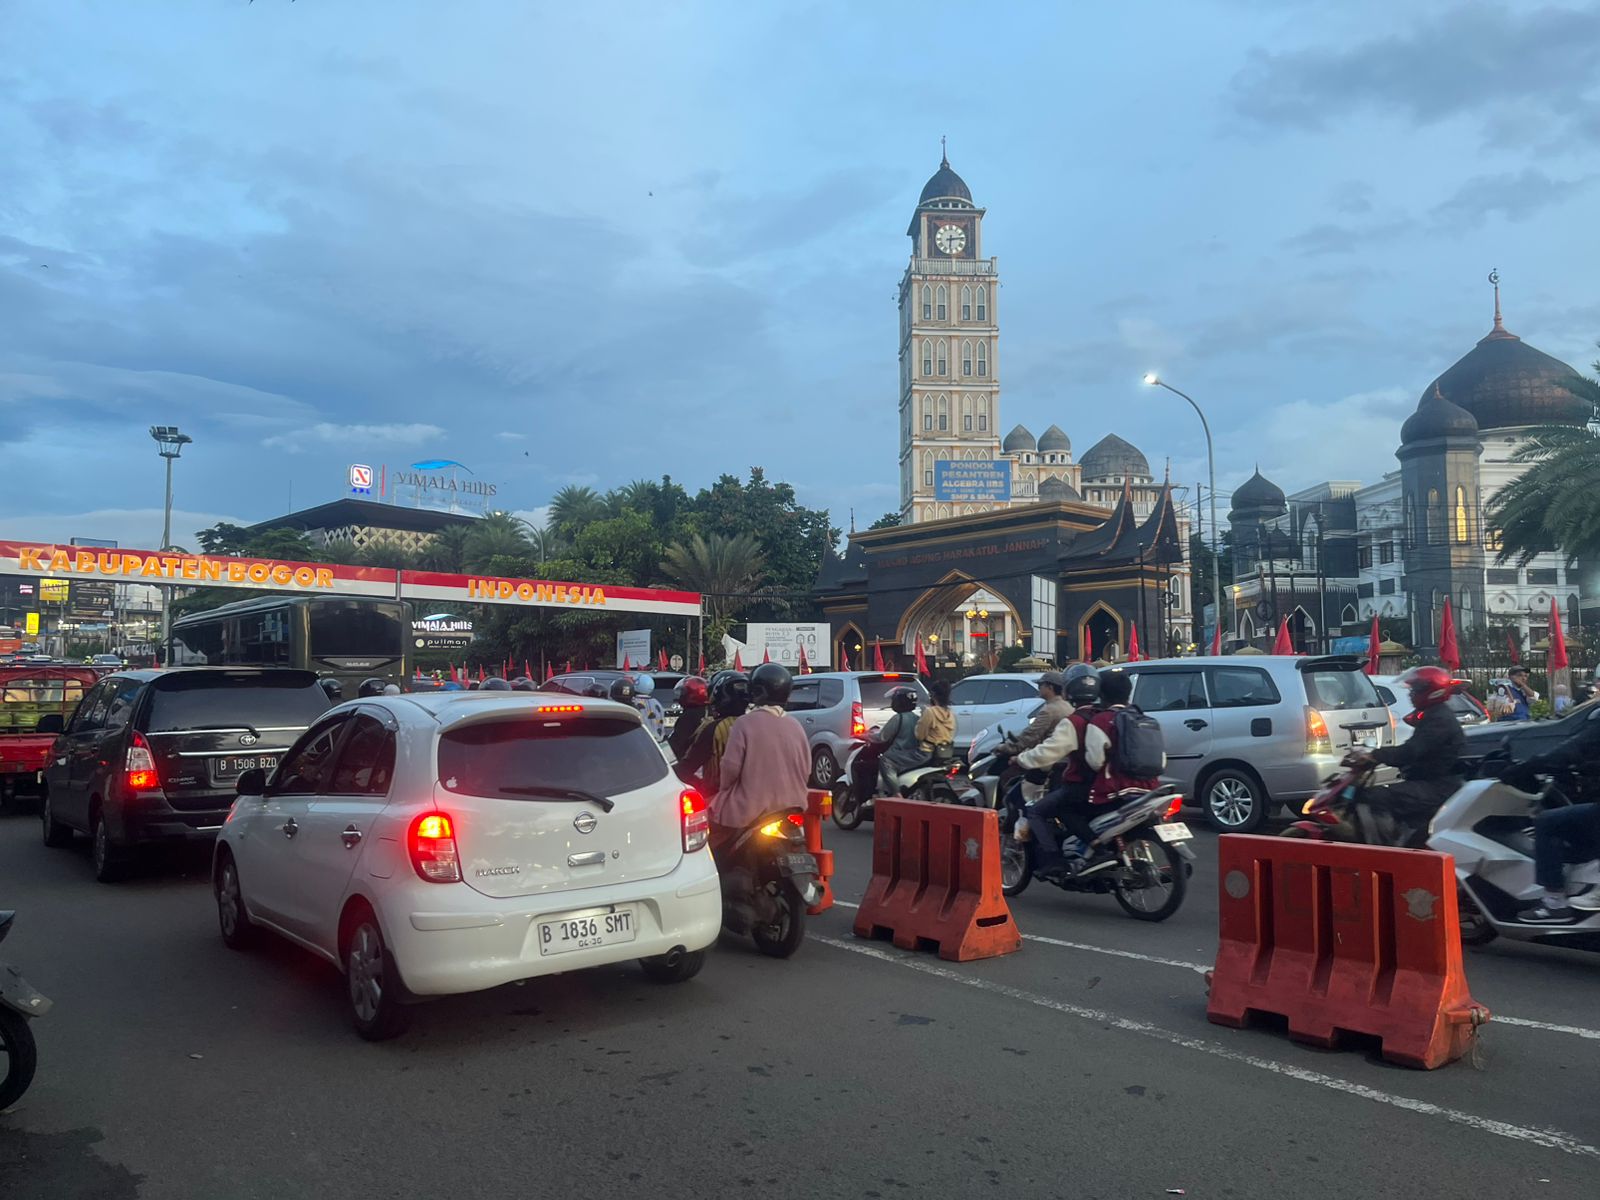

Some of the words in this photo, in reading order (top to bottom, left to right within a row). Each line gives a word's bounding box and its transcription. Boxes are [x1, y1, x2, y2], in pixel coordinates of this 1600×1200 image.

[1003, 539, 1046, 553] JANNAH
[18, 548, 222, 582] KABUPATEN
[228, 562, 334, 588] BOGOR
[467, 579, 606, 605] INDONESIA
[220, 760, 227, 771] B
[233, 758, 256, 769] 1506
[260, 757, 277, 768] BZD
[542, 925, 552, 943] B
[560, 919, 598, 940] 1836
[605, 913, 631, 933] SMT
